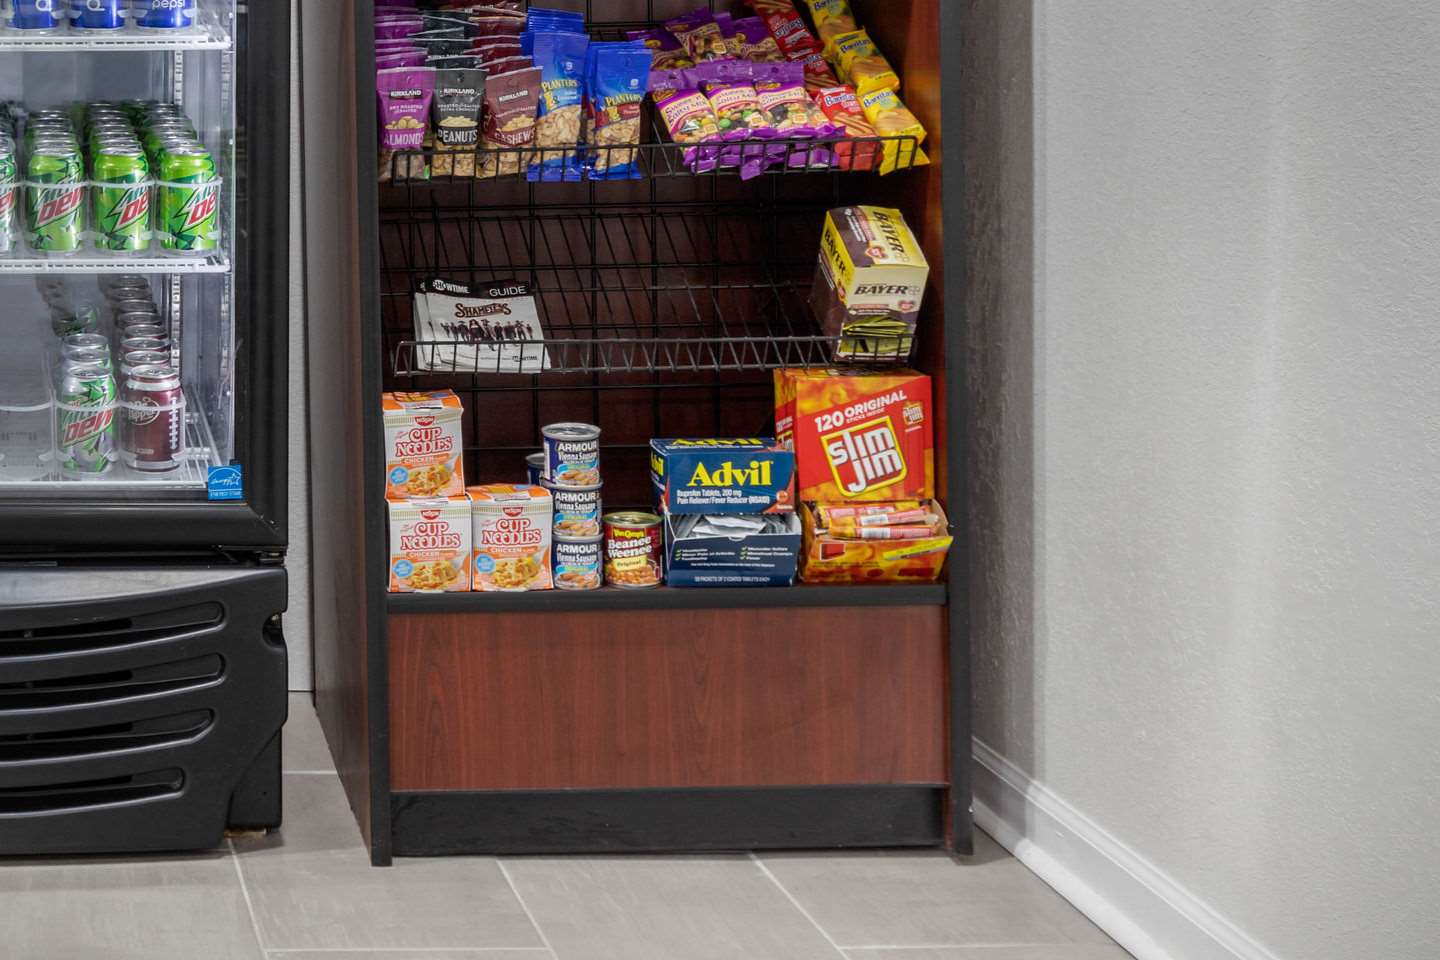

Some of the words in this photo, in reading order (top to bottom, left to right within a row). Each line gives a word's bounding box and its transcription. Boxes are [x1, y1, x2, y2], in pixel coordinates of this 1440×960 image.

[541, 79, 578, 93] PLANTERS
[437, 128, 479, 144] PEANUTS
[872, 211, 905, 254] BAYER
[489, 285, 527, 297] GUIDE
[854, 284, 909, 296] BAYER
[815, 411, 844, 432] 120
[844, 390, 908, 417] ORIGINAL
[409, 427, 442, 442] CUP
[396, 437, 452, 458] NOODLES
[558, 441, 597, 452] ARMOUR
[686, 460, 772, 486] Advil
[555, 492, 596, 502] ARMOUR
[415, 521, 448, 537] CUP
[496, 518, 531, 533] CUP
[400, 534, 461, 551] NOODLES
[482, 529, 542, 547] NOODLES
[557, 543, 598, 554] ARMOUR
